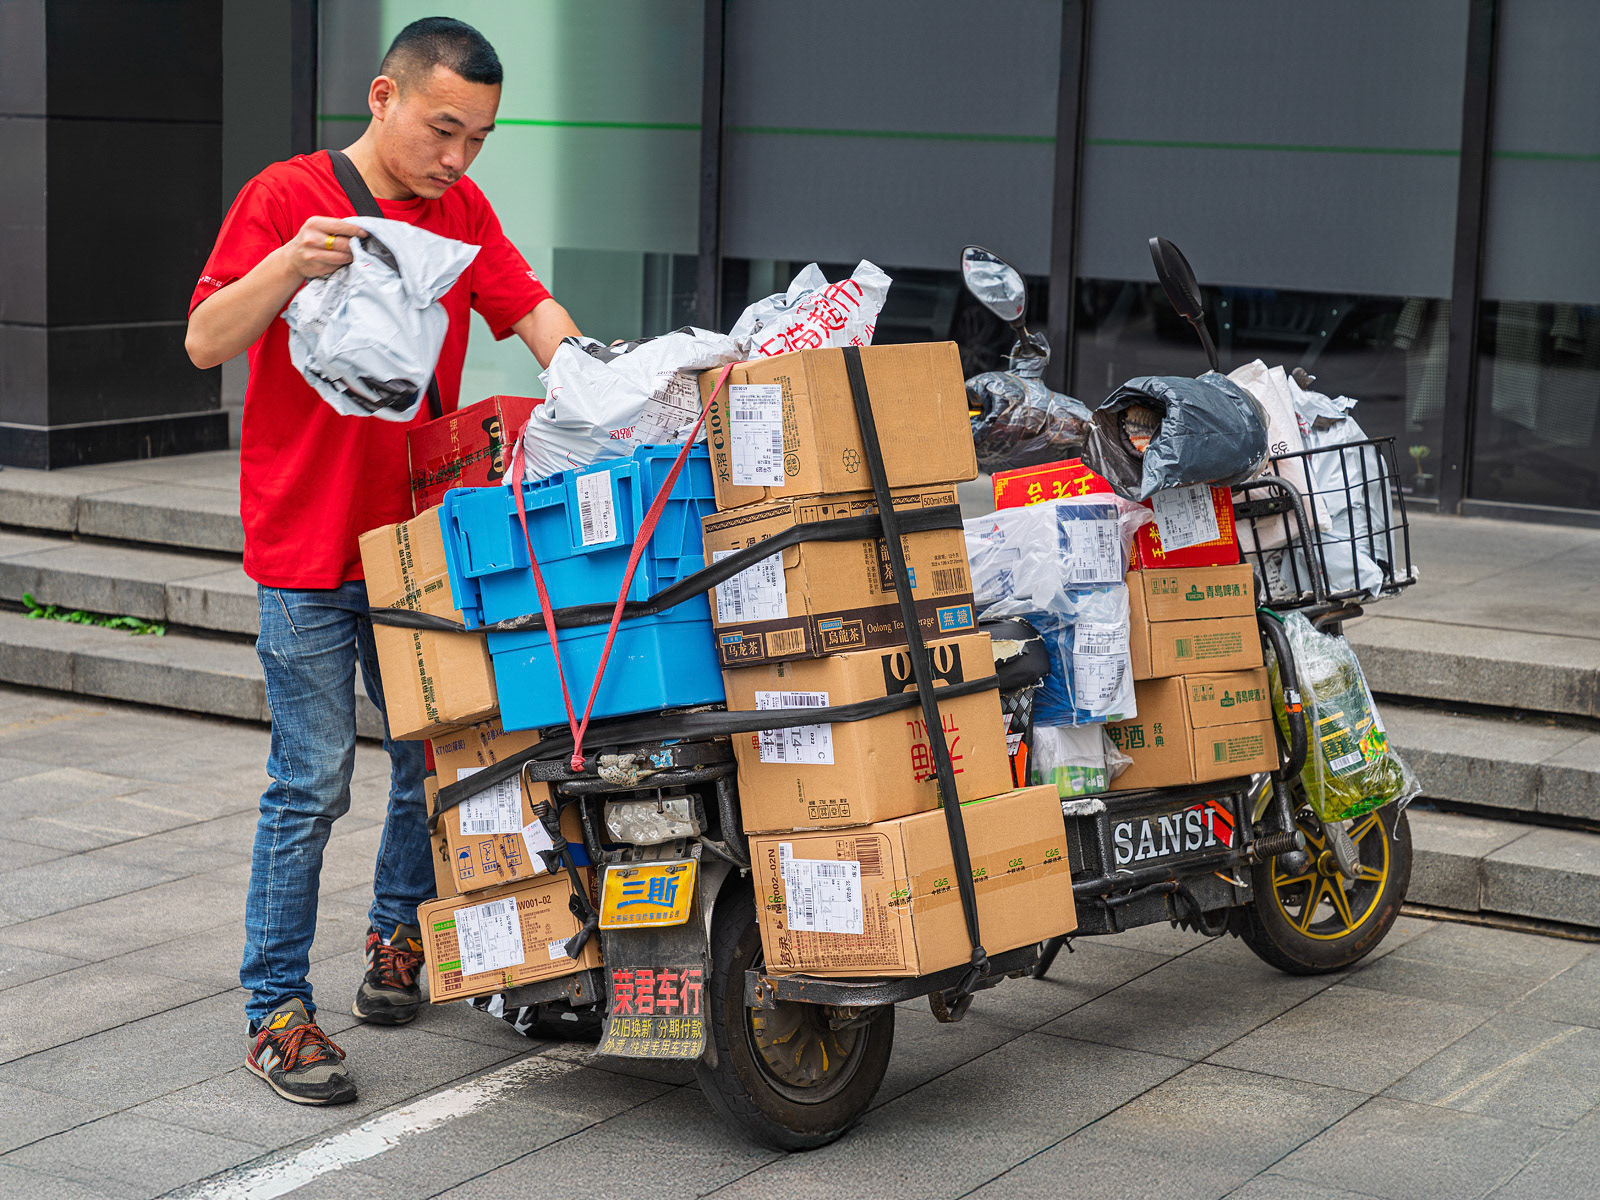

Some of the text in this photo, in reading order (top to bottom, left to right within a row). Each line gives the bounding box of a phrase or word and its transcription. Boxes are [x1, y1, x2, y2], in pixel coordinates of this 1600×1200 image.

[867, 621, 891, 634] Oolong
[893, 619, 904, 630] Tea
[828, 628, 860, 644] 烏龍茶
[728, 642, 758, 657] 乌龙茶
[792, 729, 801, 748] T4
[1154, 723, 1164, 747] 经典
[1114, 808, 1218, 866] SANSI
[1046, 848, 1059, 857] C&S
[1008, 858, 1023, 867] C&S
[933, 878, 948, 888] C&S
[617, 876, 680, 910] 三斯
[890, 889, 909, 899] C&S
[516, 895, 552, 910] W001-02
[614, 968, 702, 1014] 荣君车行
[610, 1019, 702, 1038] 以旧换新 分期付款
